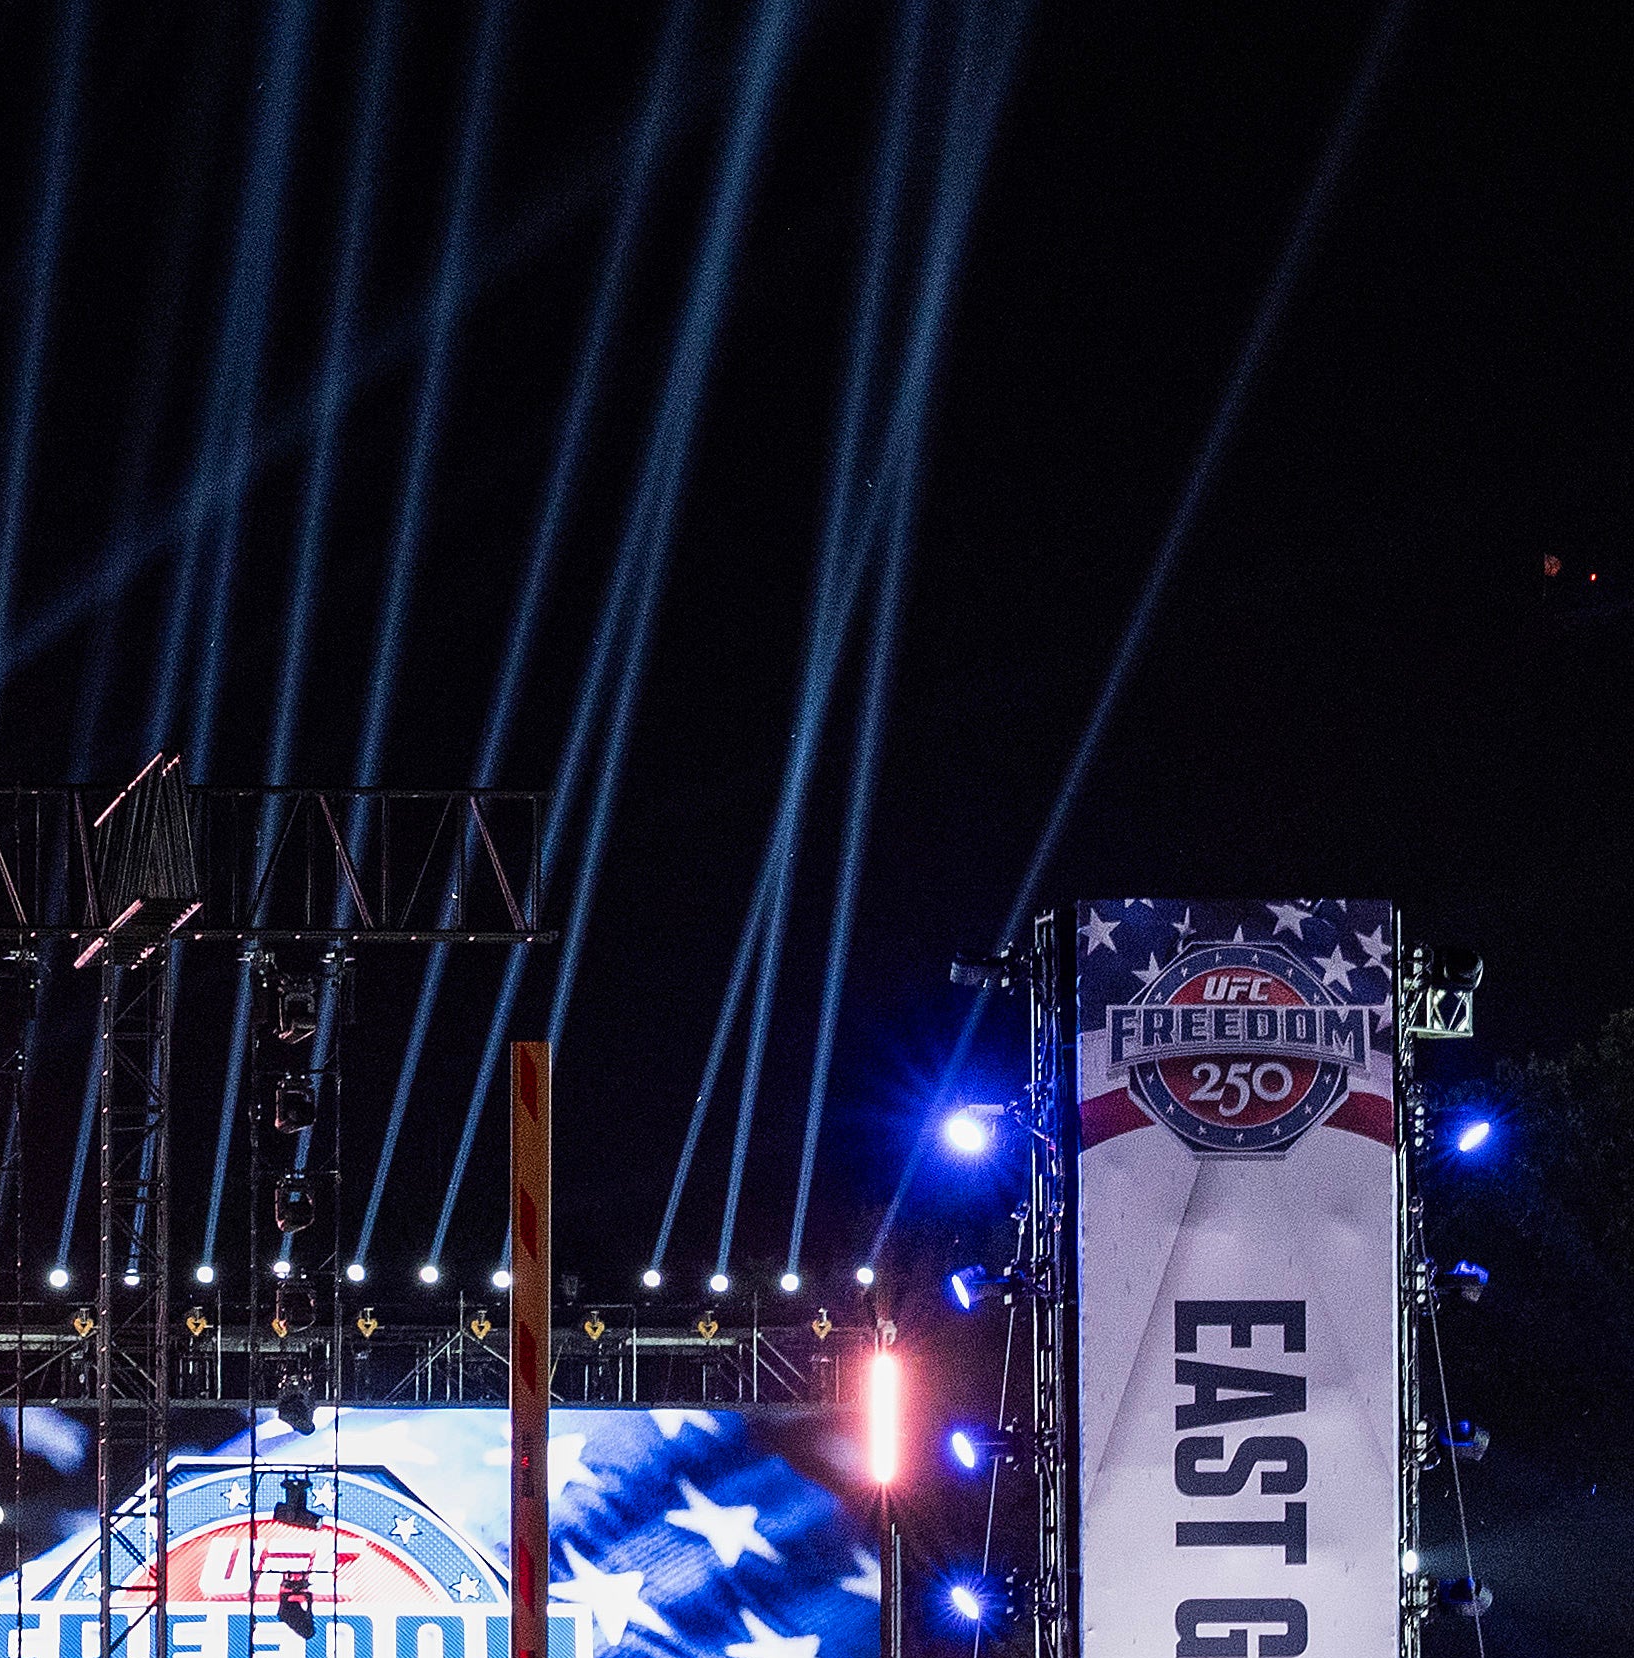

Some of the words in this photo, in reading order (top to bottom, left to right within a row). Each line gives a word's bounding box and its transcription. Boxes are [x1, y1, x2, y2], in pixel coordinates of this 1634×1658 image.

[1203, 977, 1272, 1002] UFC
[1111, 1009, 1367, 1061] FREEDOM
[1189, 1062, 1294, 1117] 250
[1174, 1300, 1308, 1566] EAST
